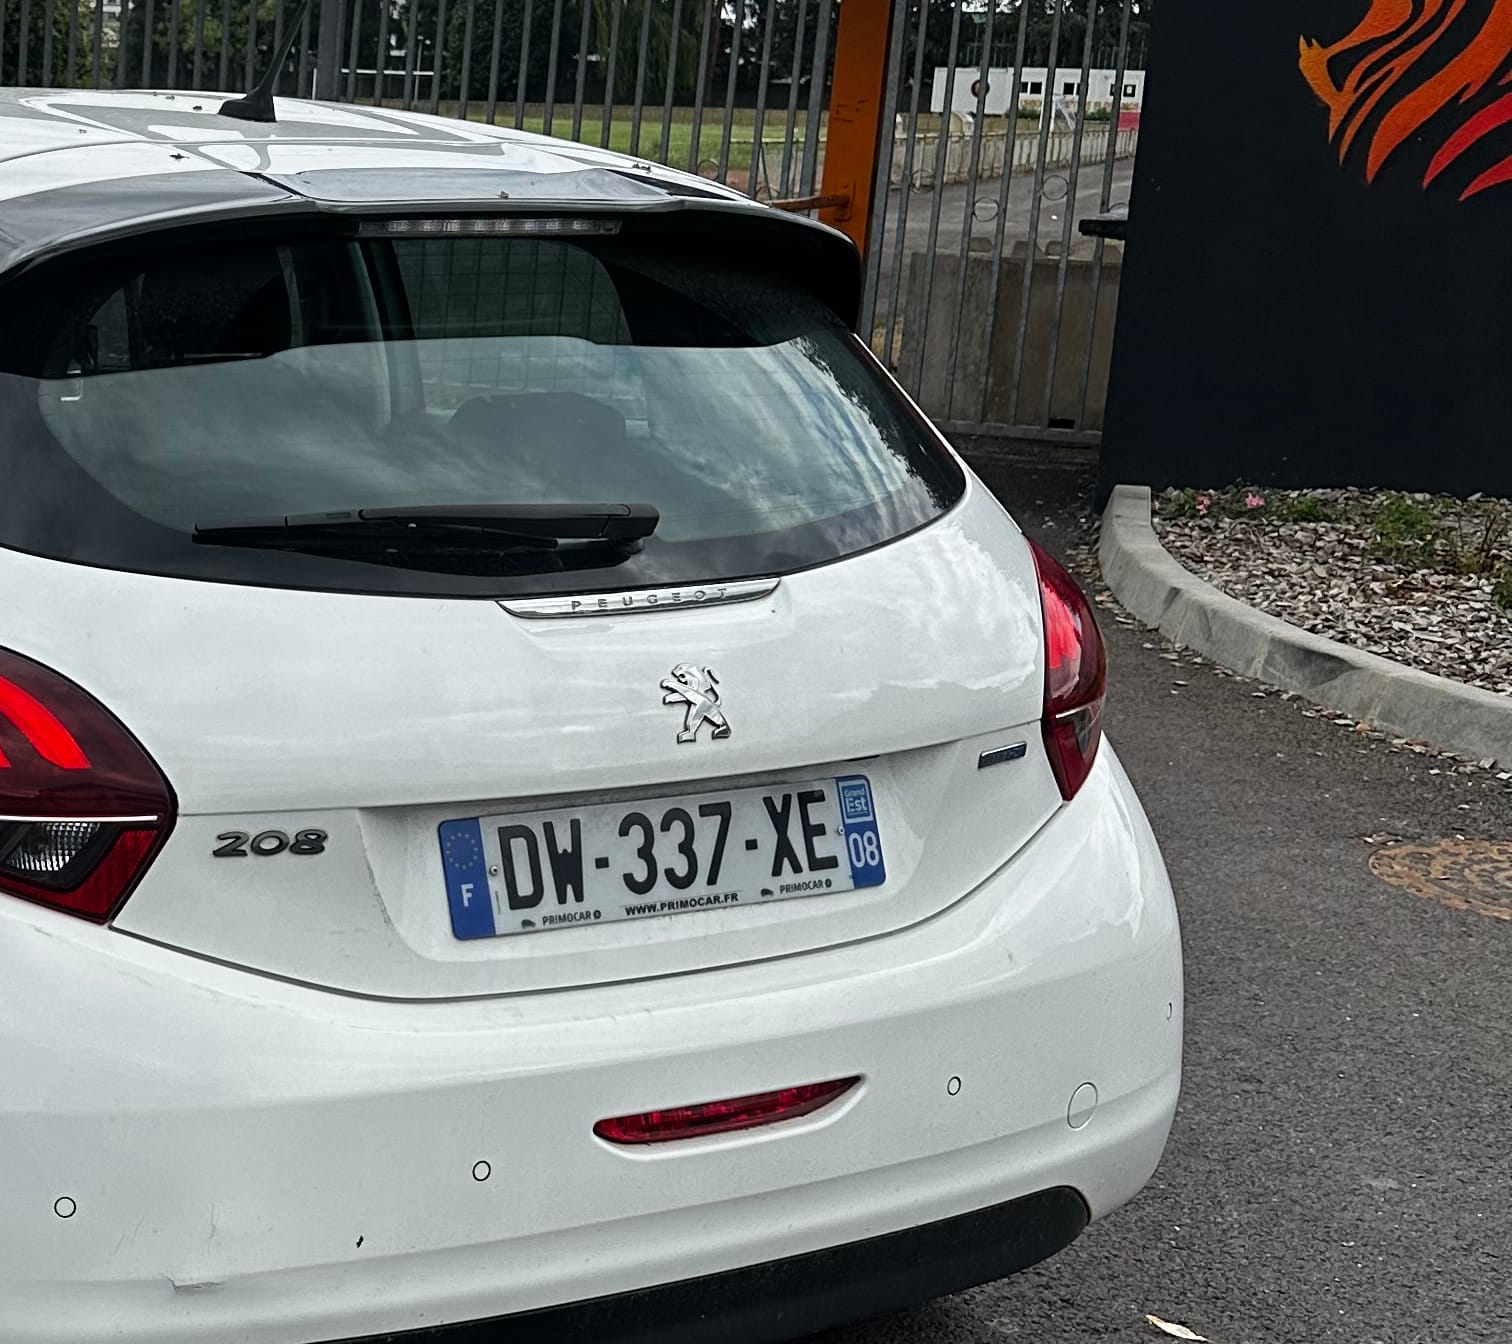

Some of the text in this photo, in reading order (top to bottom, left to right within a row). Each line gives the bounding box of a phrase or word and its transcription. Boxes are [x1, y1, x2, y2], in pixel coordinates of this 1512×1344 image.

[571, 587, 727, 610] PEUGEOT
[846, 796, 867, 813] Est
[212, 829, 328, 857] 208
[497, 789, 839, 910] DW-337-XE
[849, 831, 880, 868] 08
[461, 883, 473, 907] F
[779, 879, 826, 895] PRIMOCAR
[625, 892, 739, 917] WWW.PRIMOCAR.FR
[542, 910, 592, 927] PRIMOCAR
